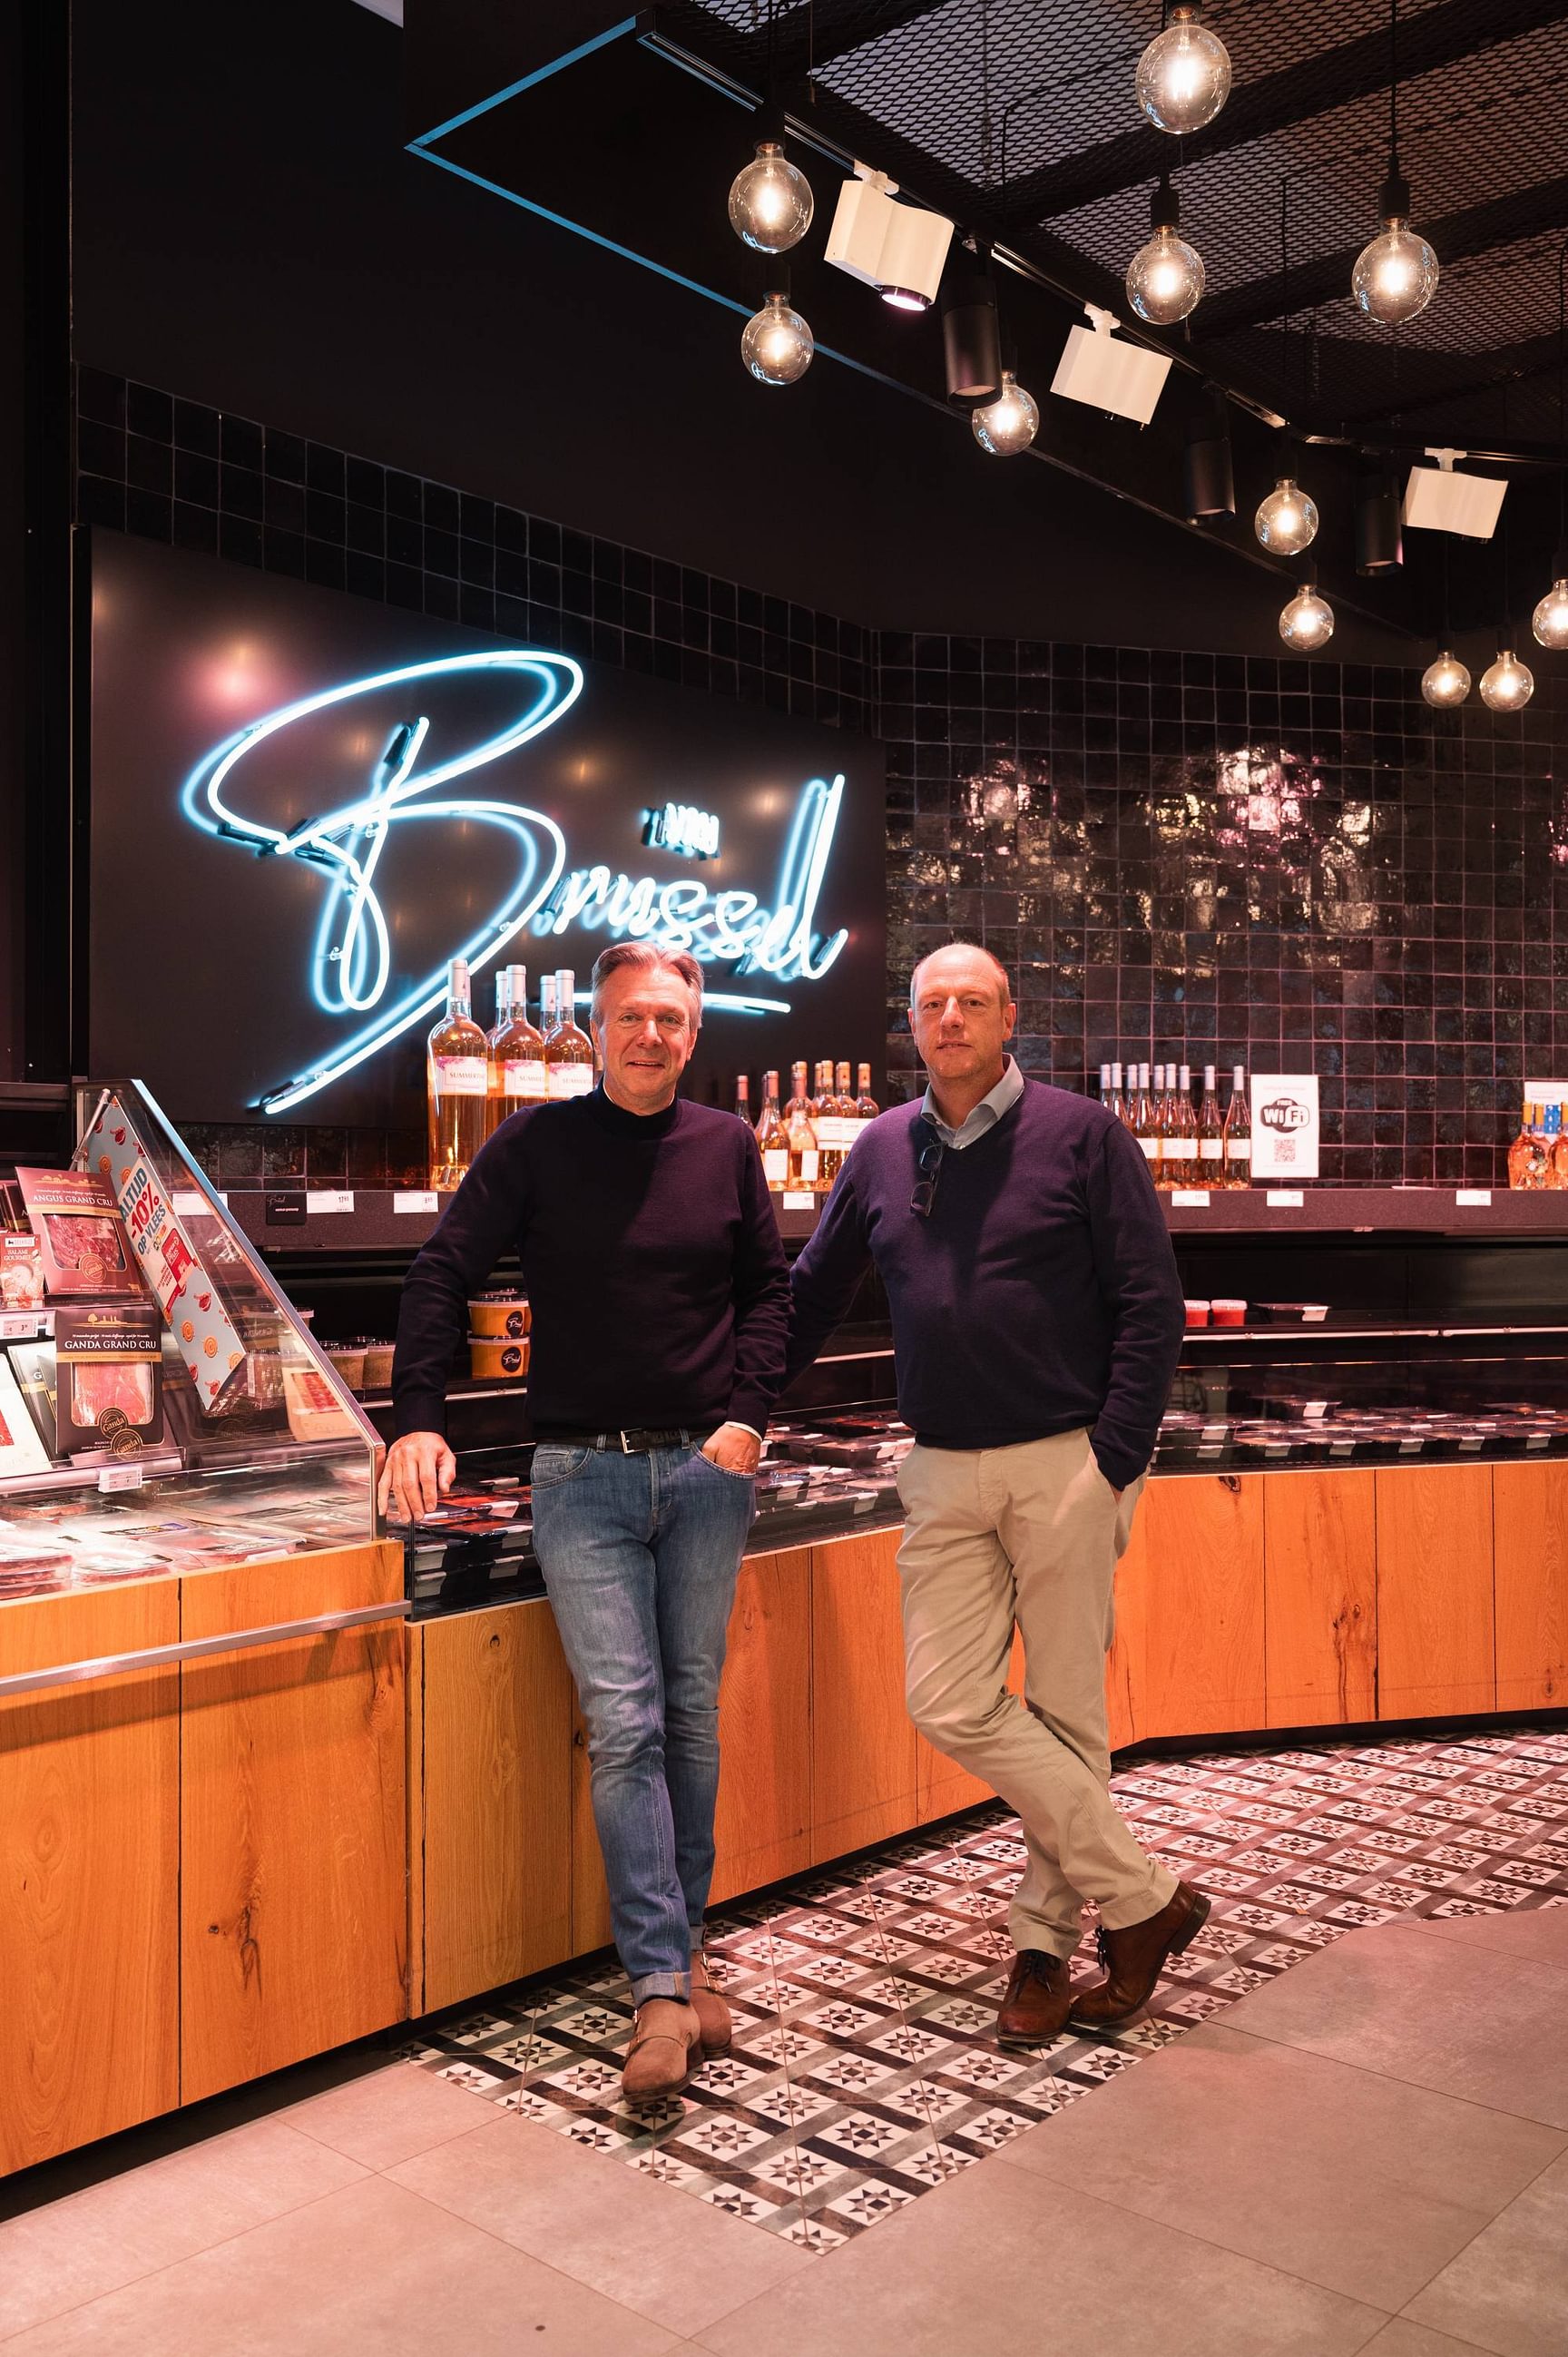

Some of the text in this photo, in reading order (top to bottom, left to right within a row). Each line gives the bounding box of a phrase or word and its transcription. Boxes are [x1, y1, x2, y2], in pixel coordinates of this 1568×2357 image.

[34, 1194, 113, 1207] ANGUS GRAND CRU
[120, 1167, 147, 1223] ALTIJD
[132, 1183, 159, 1239] -10%
[137, 1203, 166, 1255] OP VLEES
[64, 1341, 156, 1350] GANDA GRAND CRU
[103, 1416, 125, 1432] Ganda
[116, 1439, 138, 1455] Ganda
